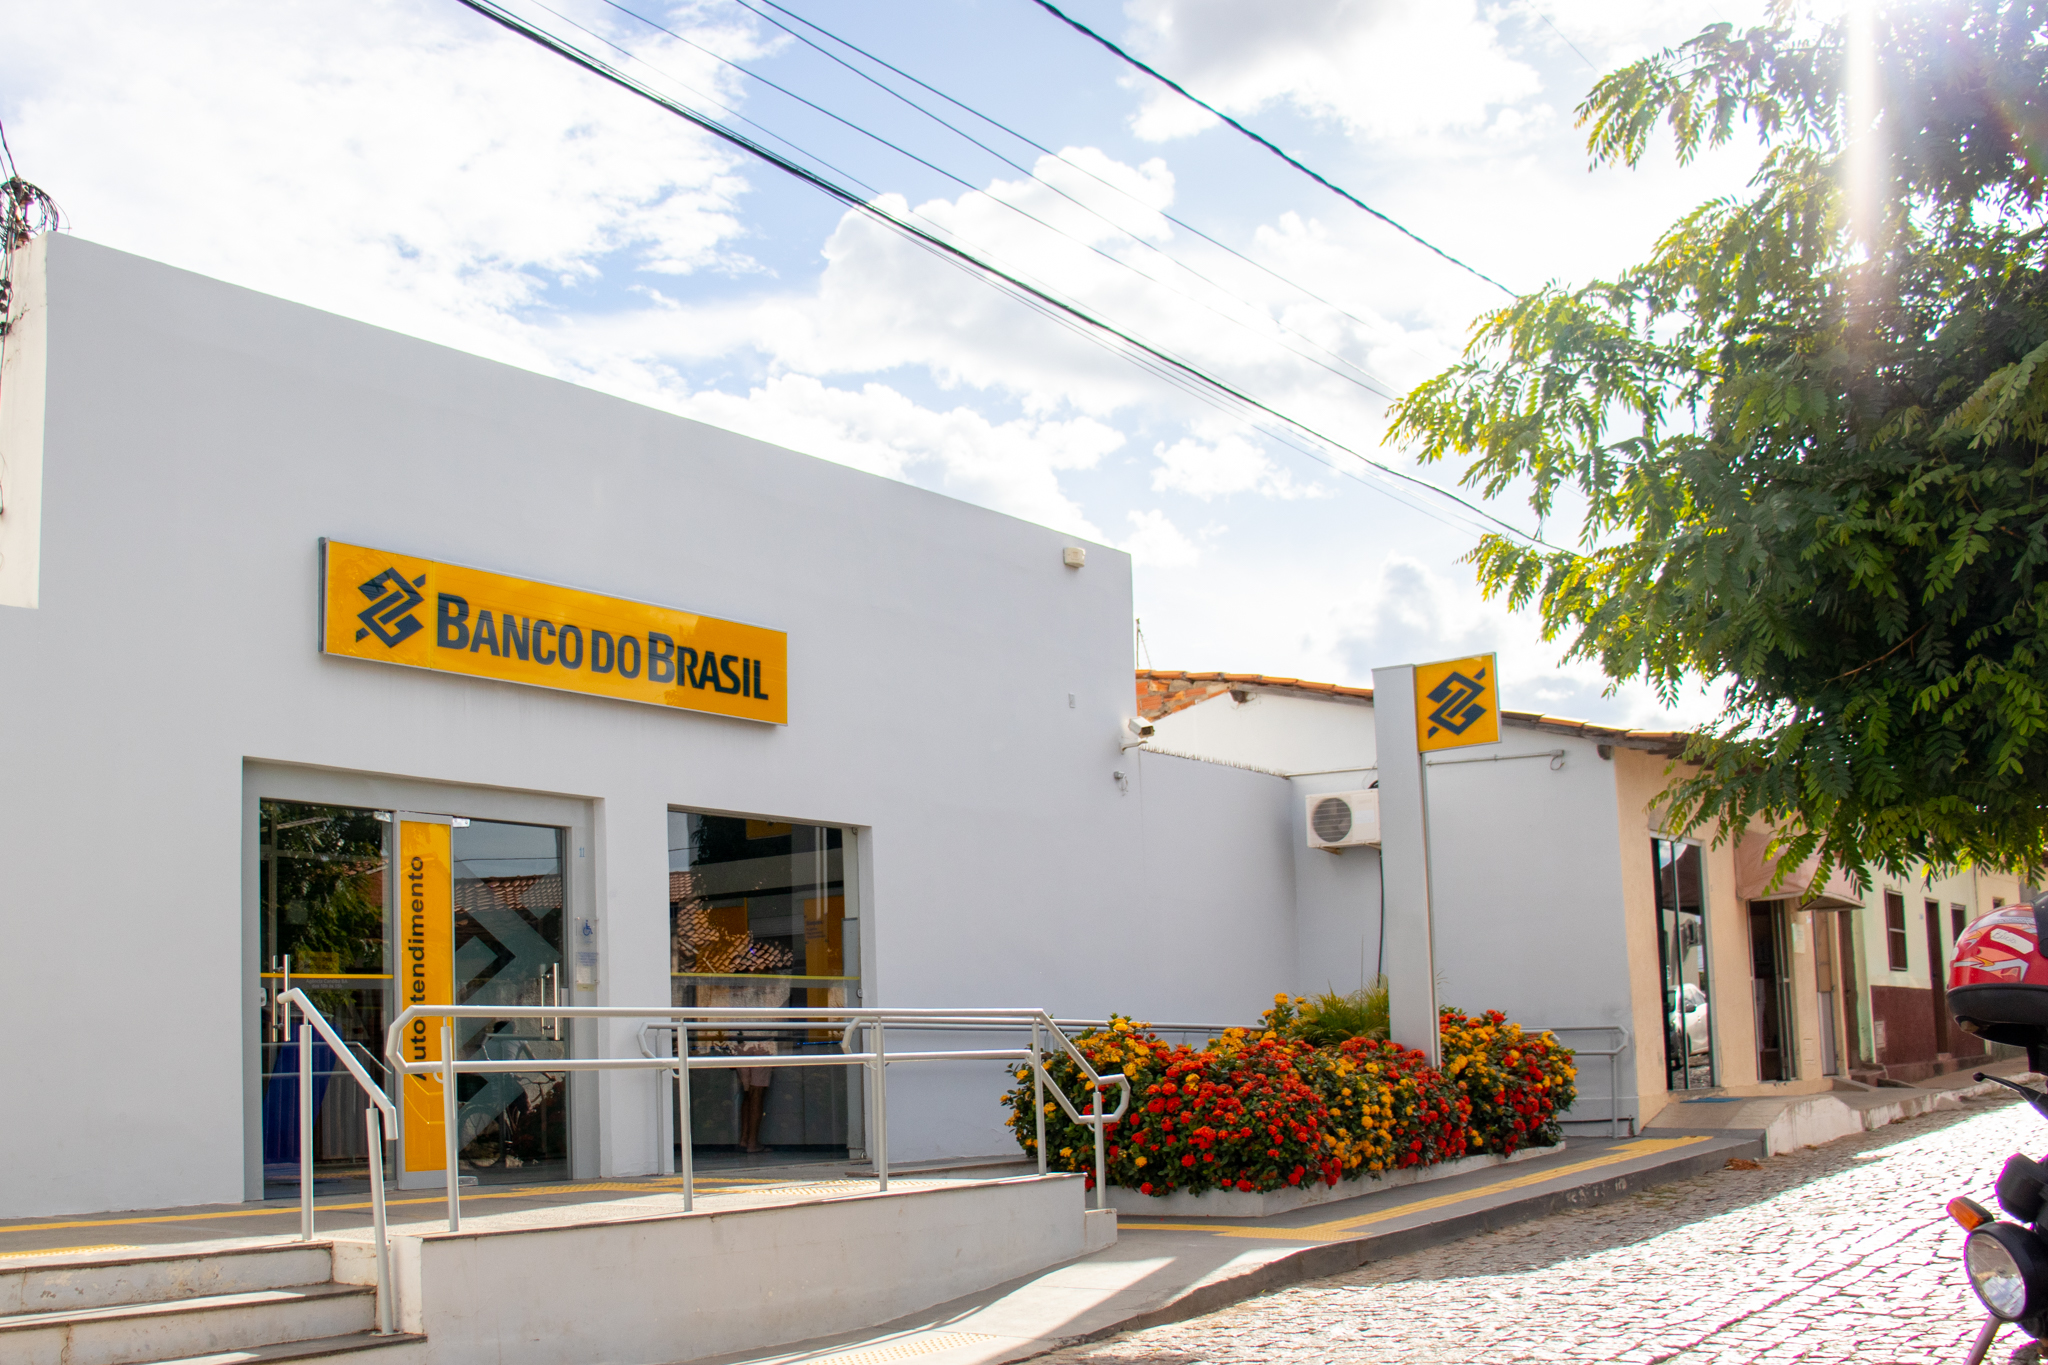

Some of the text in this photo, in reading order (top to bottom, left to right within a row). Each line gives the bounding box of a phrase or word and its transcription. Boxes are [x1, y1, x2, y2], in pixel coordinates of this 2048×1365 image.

[437, 593, 769, 700] BANCO DO BRASIL
[408, 856, 427, 1081] utotendimento
